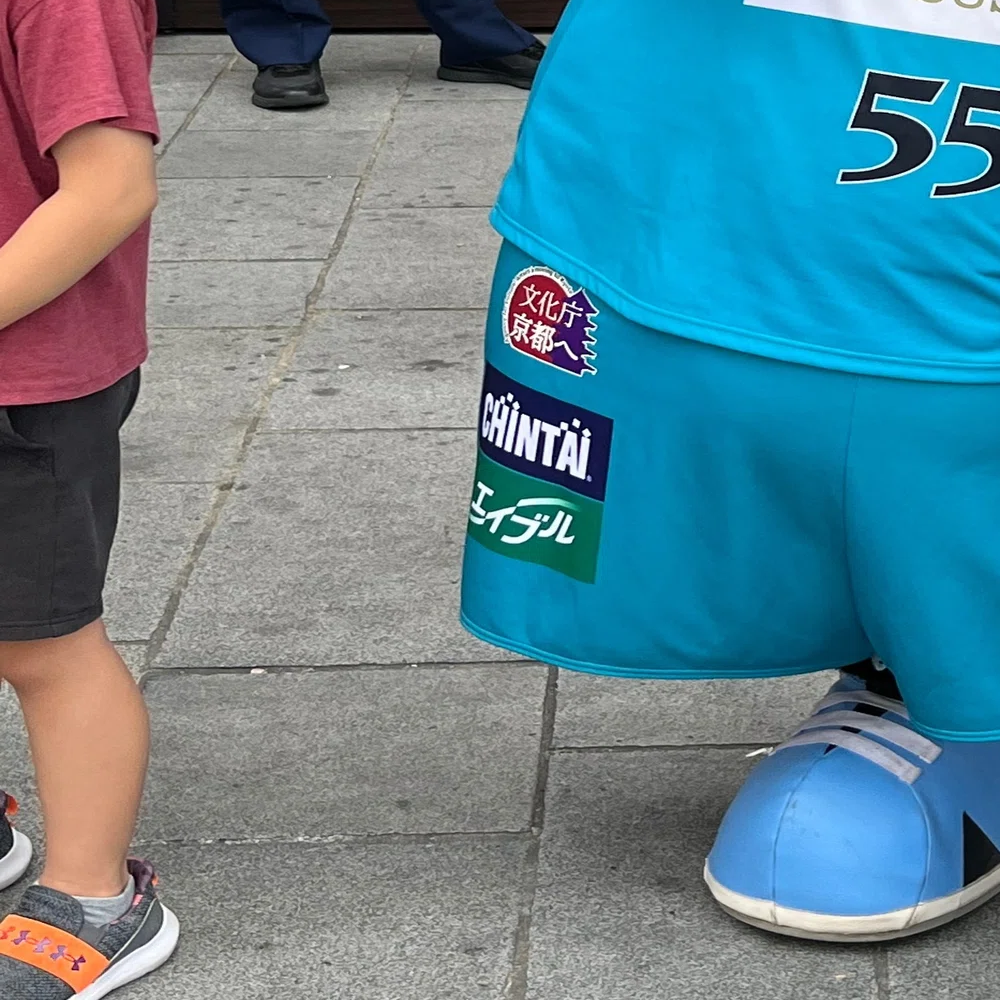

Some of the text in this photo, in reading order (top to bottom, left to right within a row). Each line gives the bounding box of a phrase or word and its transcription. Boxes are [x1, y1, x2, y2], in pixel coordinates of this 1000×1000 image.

[518, 283, 584, 328] 文化庁
[509, 313, 579, 361] 京都へ
[469, 481, 576, 545] エイブル
